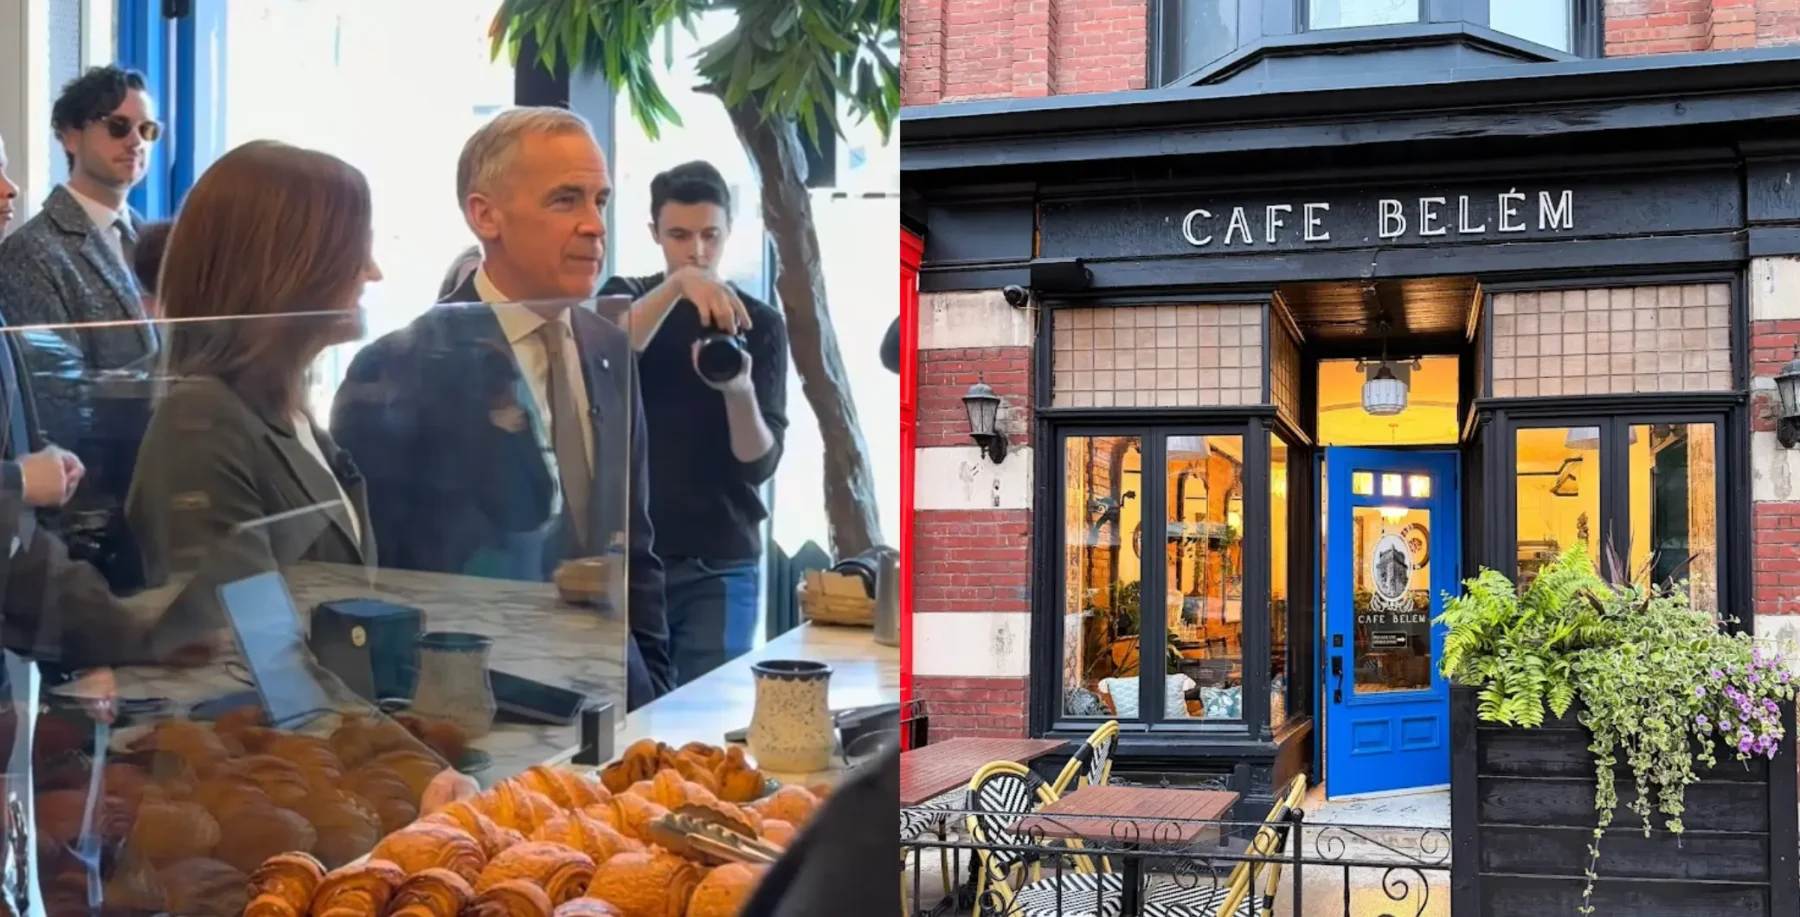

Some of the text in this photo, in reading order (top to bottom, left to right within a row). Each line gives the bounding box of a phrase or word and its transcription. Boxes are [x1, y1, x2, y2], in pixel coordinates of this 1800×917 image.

[1182, 187, 1574, 246] CAFE BELÉM
[1357, 614, 1386, 624] CAFE
